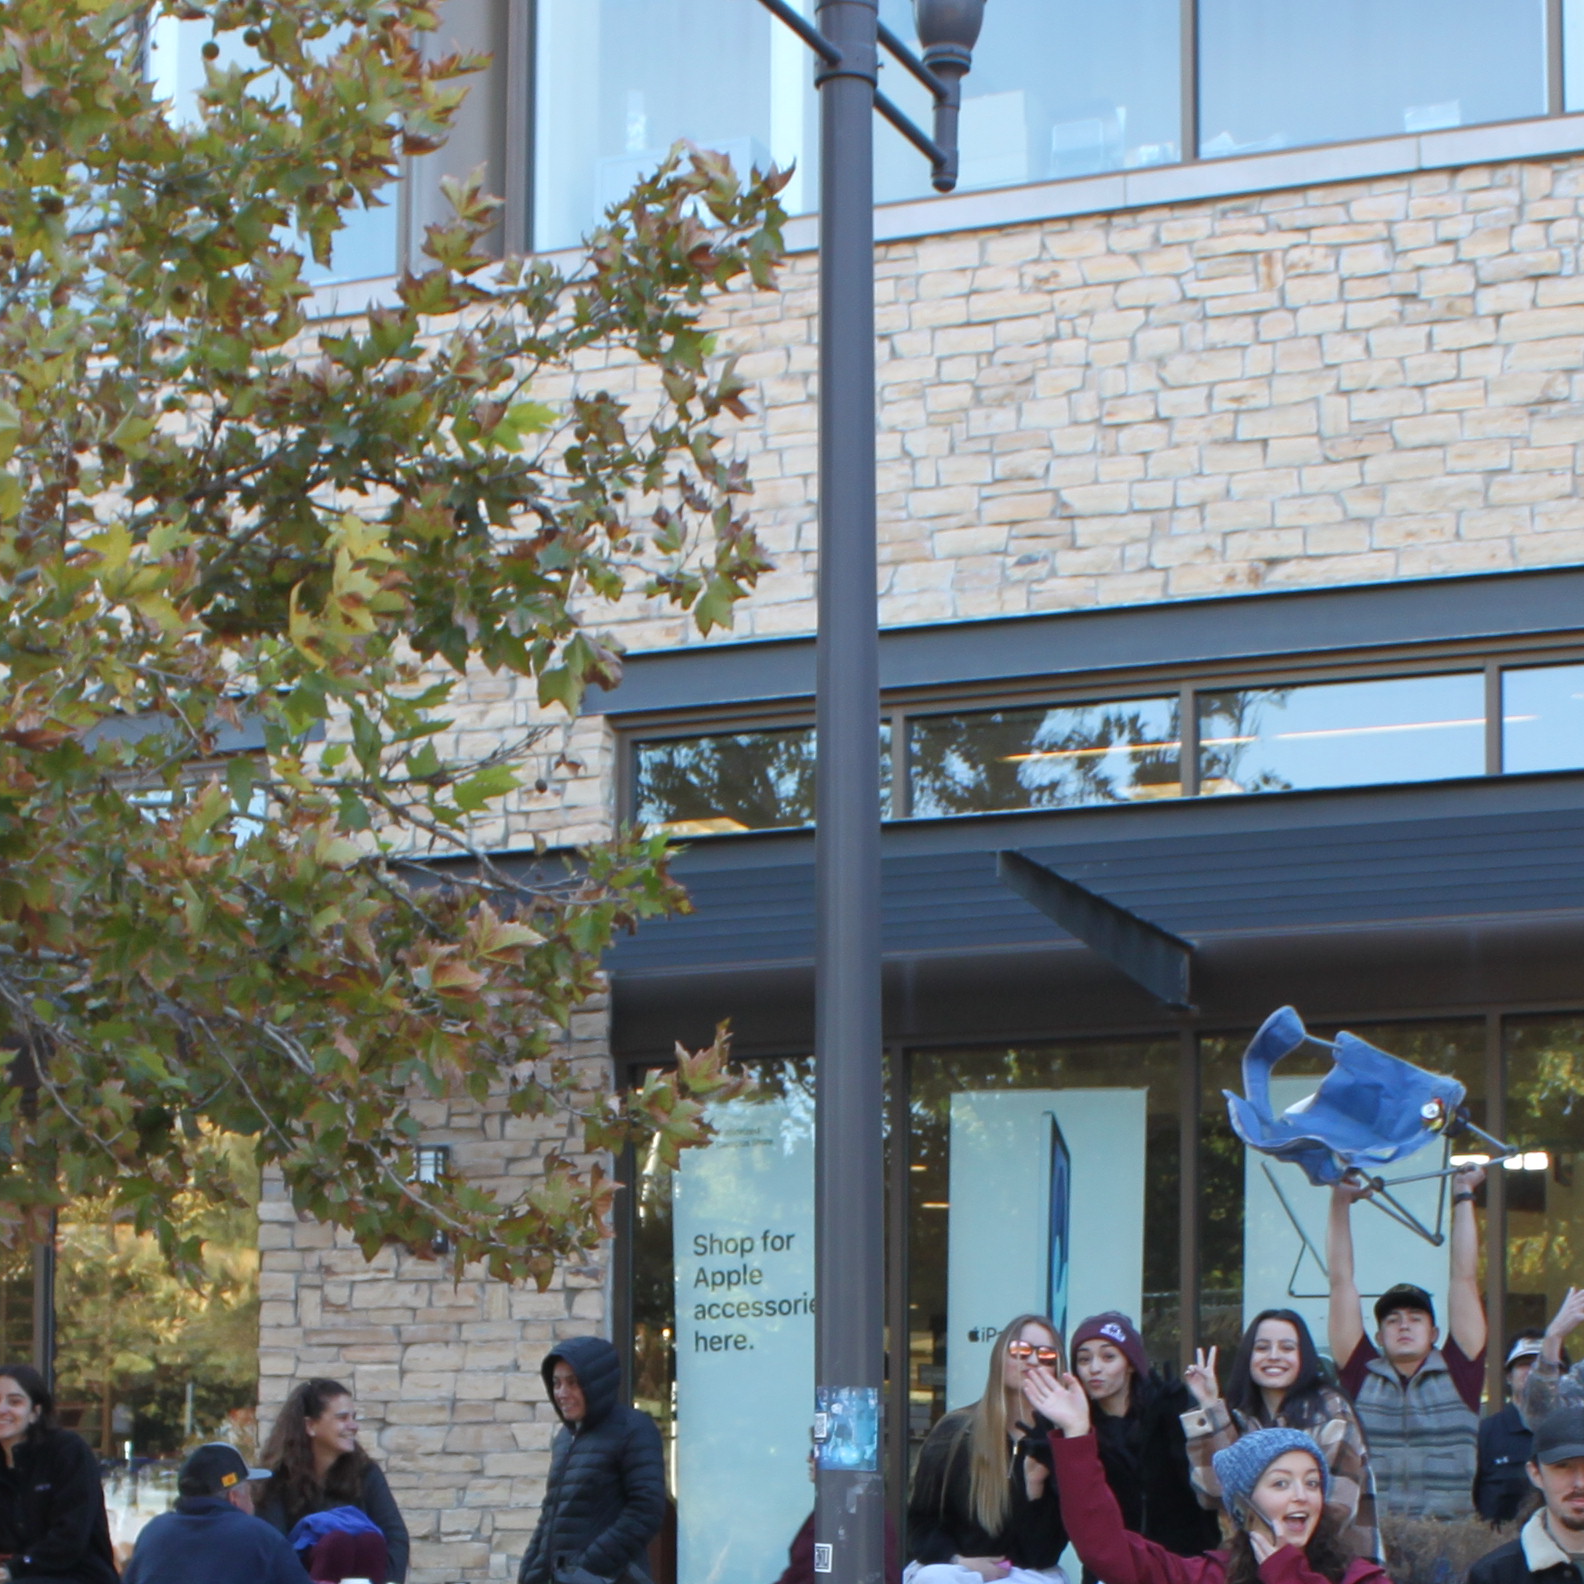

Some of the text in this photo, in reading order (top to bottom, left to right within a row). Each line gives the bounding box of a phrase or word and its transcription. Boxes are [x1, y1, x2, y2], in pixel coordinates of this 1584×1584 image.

[693, 1229, 795, 1258] Shop for
[694, 1263, 763, 1292] Apple
[694, 1330, 754, 1352] here.
[981, 1327, 1002, 1343] iP
